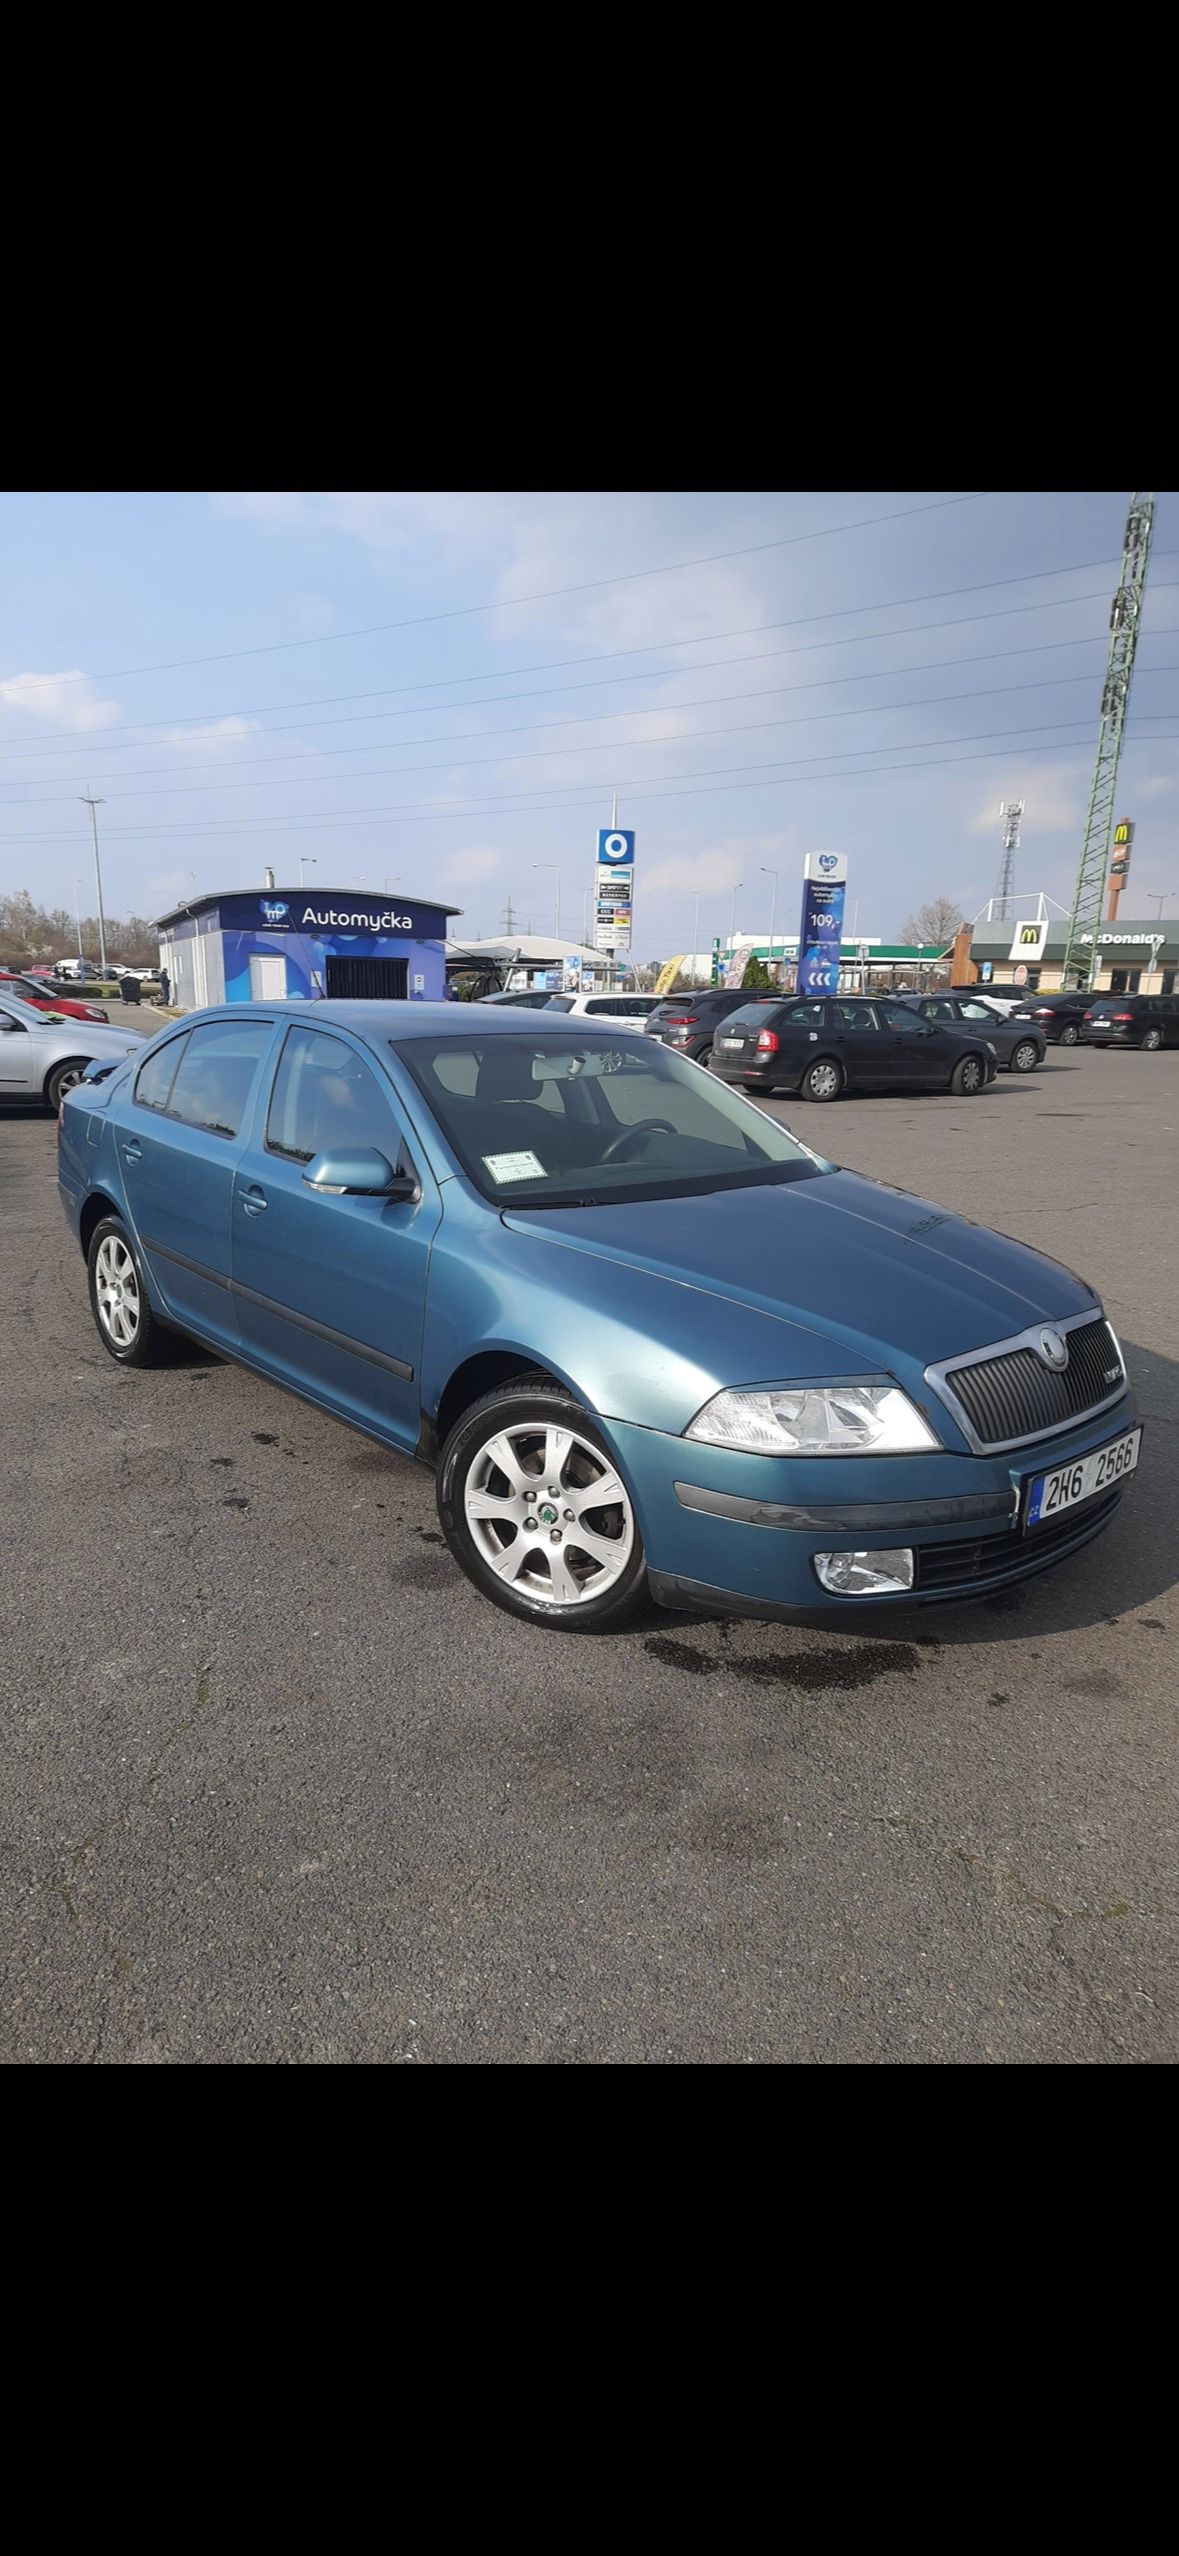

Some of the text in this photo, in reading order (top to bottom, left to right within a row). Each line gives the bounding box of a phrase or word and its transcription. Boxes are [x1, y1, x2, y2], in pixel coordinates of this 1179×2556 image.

[302, 907, 413, 931] Automyčka
[810, 914, 840, 929] 109,-
[1046, 1437, 1133, 1511] 2H6 2566
